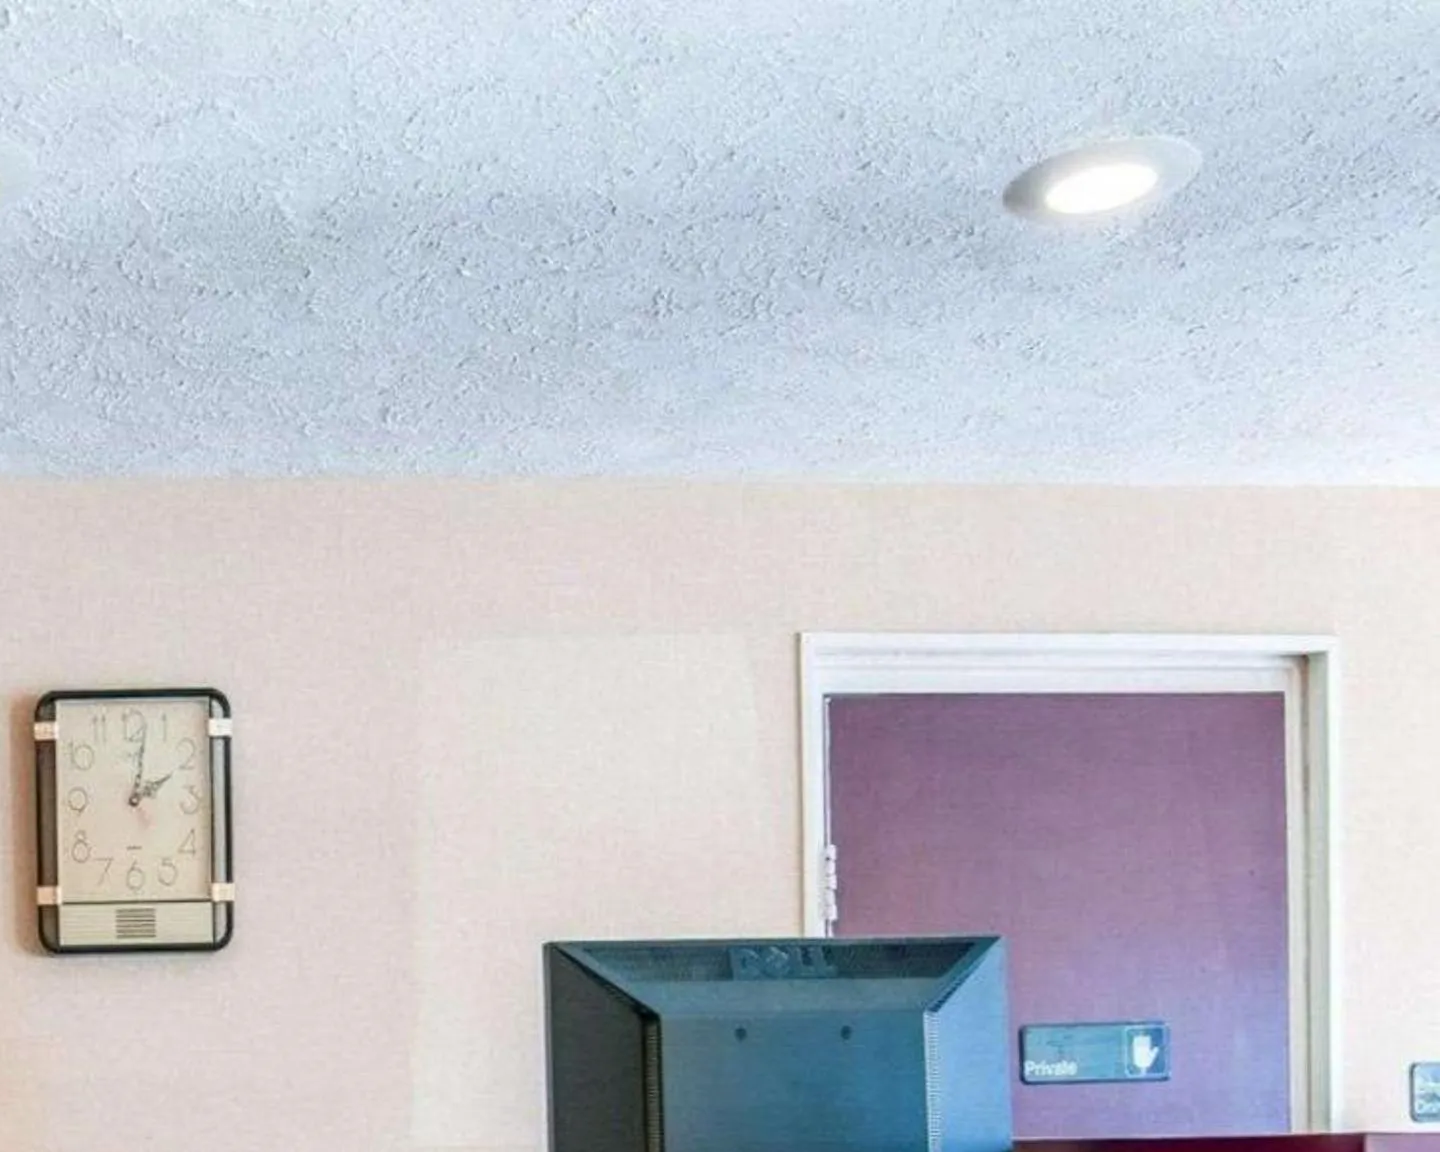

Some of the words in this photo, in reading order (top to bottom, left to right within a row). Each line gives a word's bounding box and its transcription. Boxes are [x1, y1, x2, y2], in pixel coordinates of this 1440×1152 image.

[92, 713, 108, 744] 11
[68, 740, 95, 772] 10
[176, 737, 196, 771] 2
[67, 786, 89, 816] 9
[178, 784, 201, 815] 3
[70, 829, 92, 864] 8
[177, 827, 197, 857] 4
[93, 856, 115, 887] 7
[125, 859, 146, 891] 6
[157, 856, 178, 887] 5
[728, 945, 840, 982] DELL
[1024, 1059, 1079, 1077] Private
